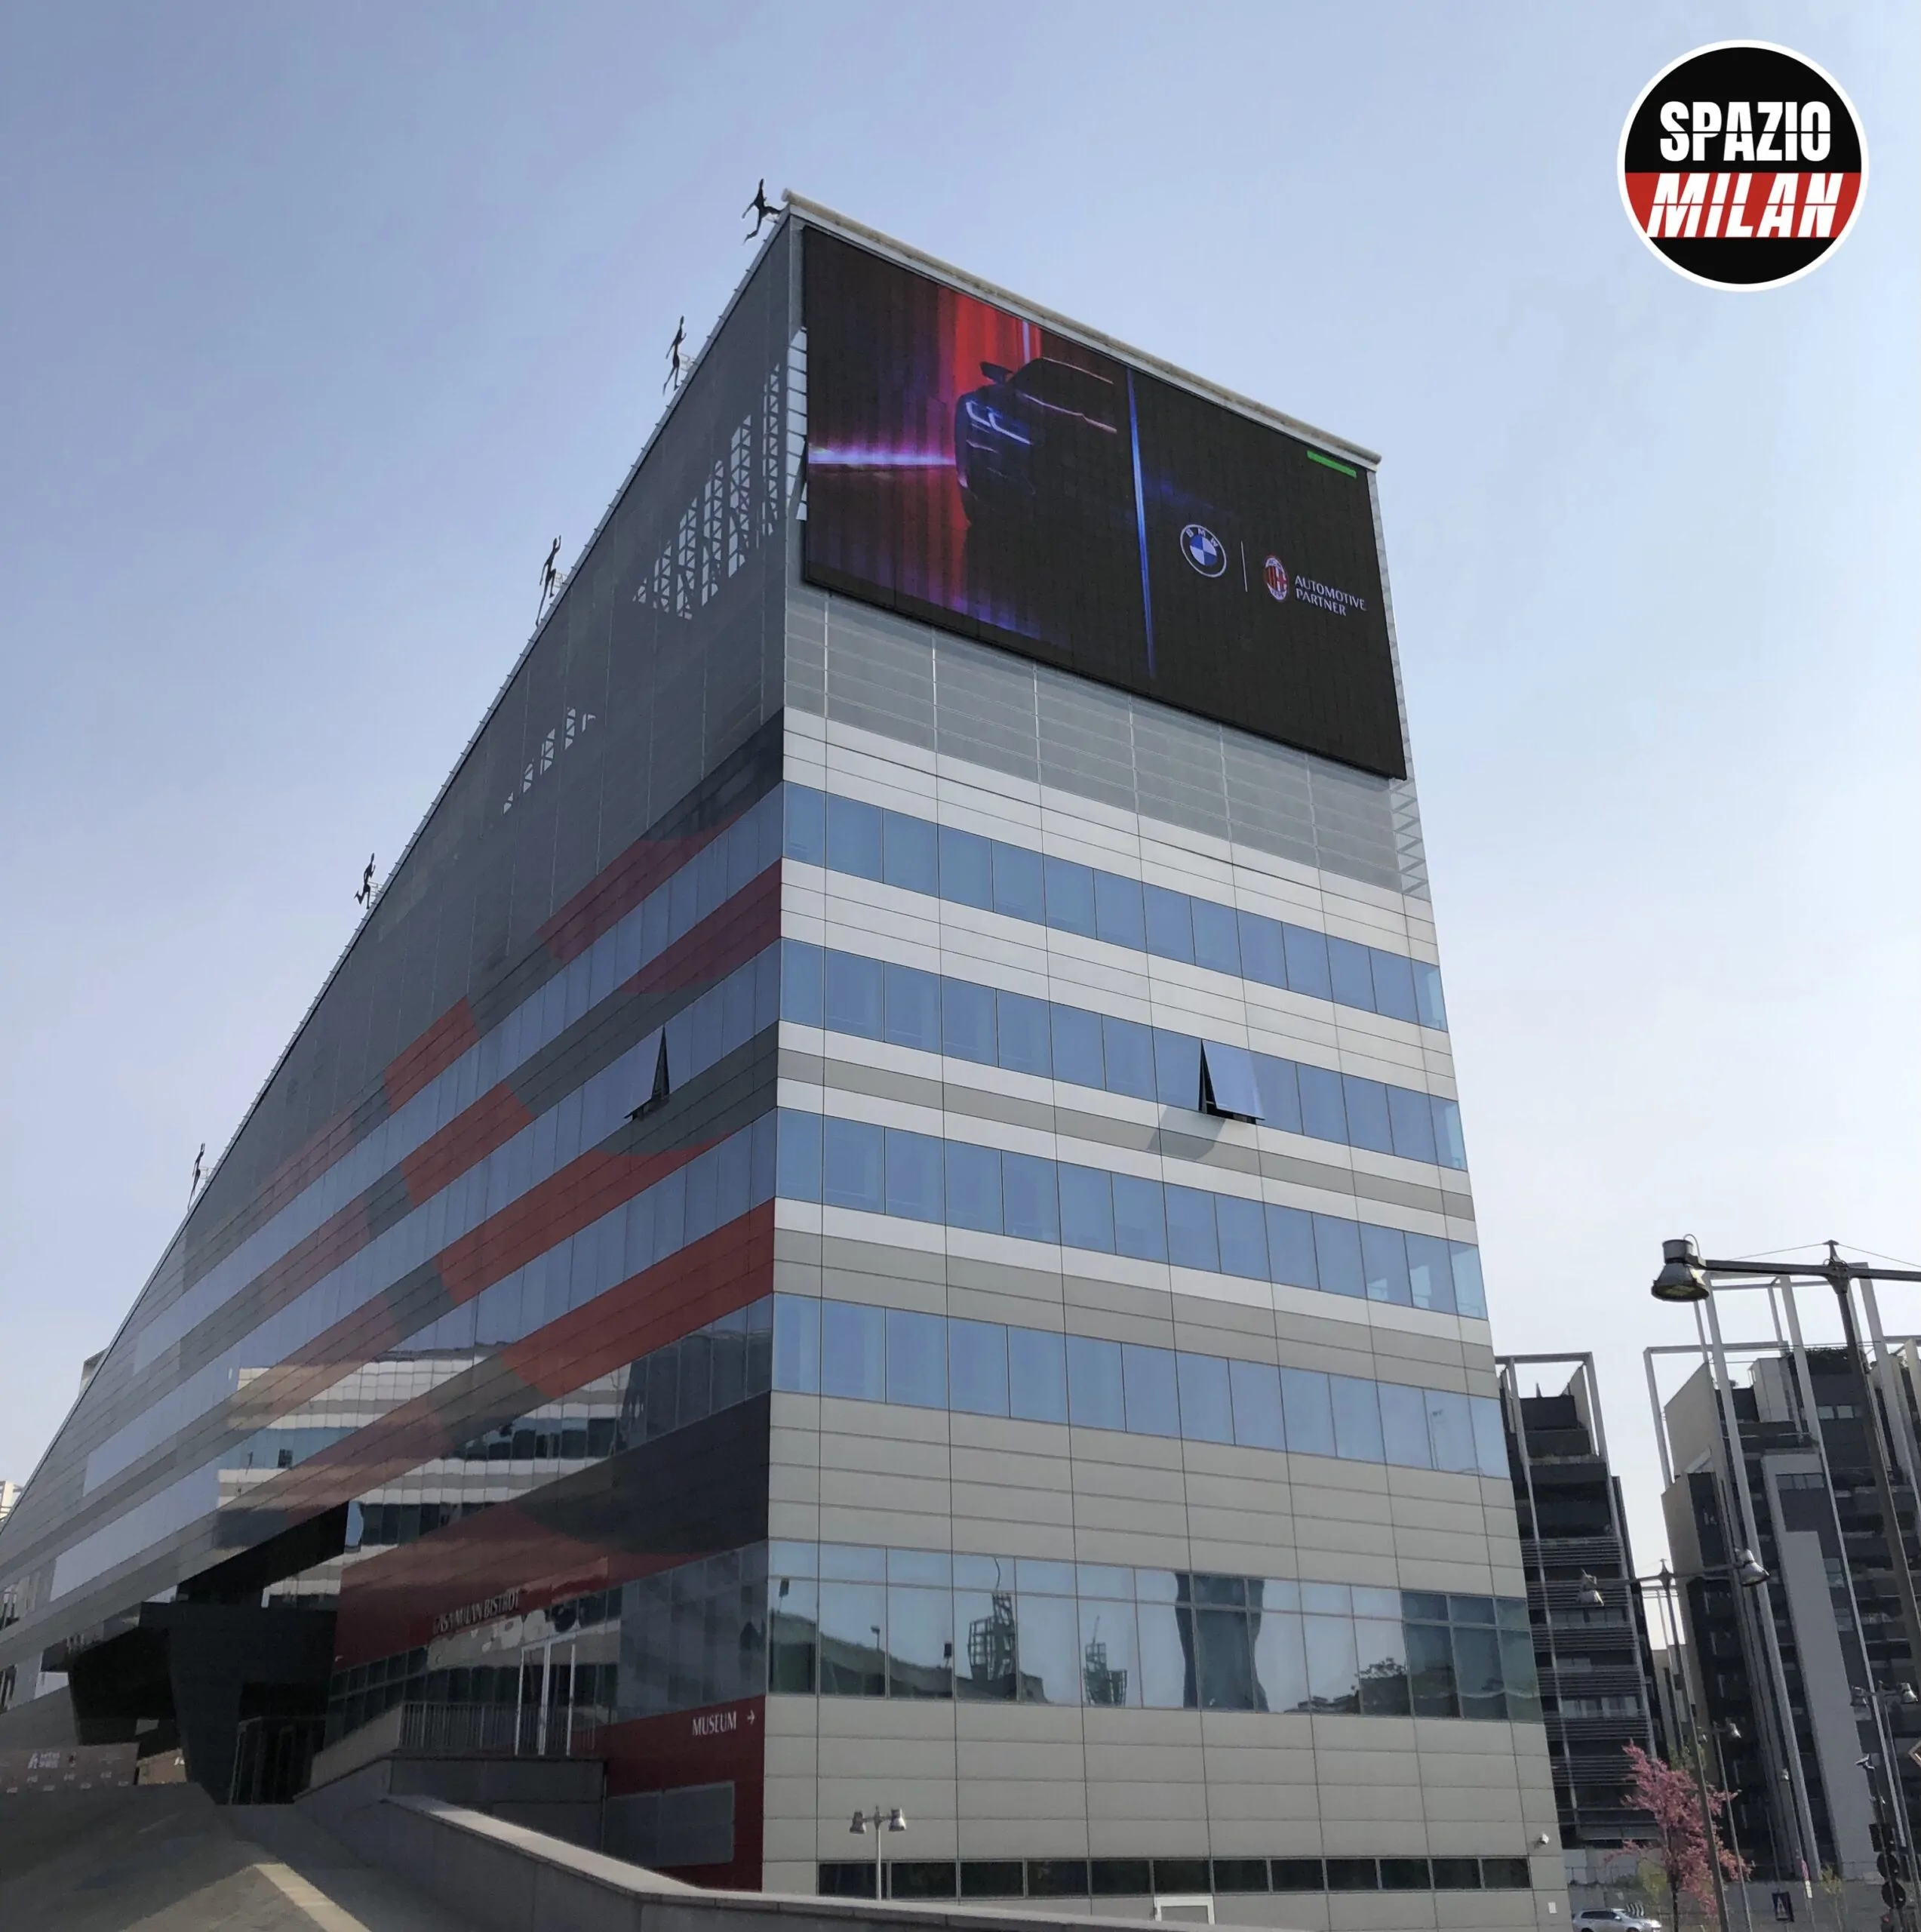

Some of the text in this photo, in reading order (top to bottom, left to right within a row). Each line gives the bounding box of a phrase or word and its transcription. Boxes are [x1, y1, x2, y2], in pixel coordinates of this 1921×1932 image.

[1185, 528, 1219, 547] BMW
[1295, 575, 1366, 611] AUTOMOTIVE
[1296, 588, 1347, 617] PARTNER
[693, 1711, 736, 1736] MUSEUM
